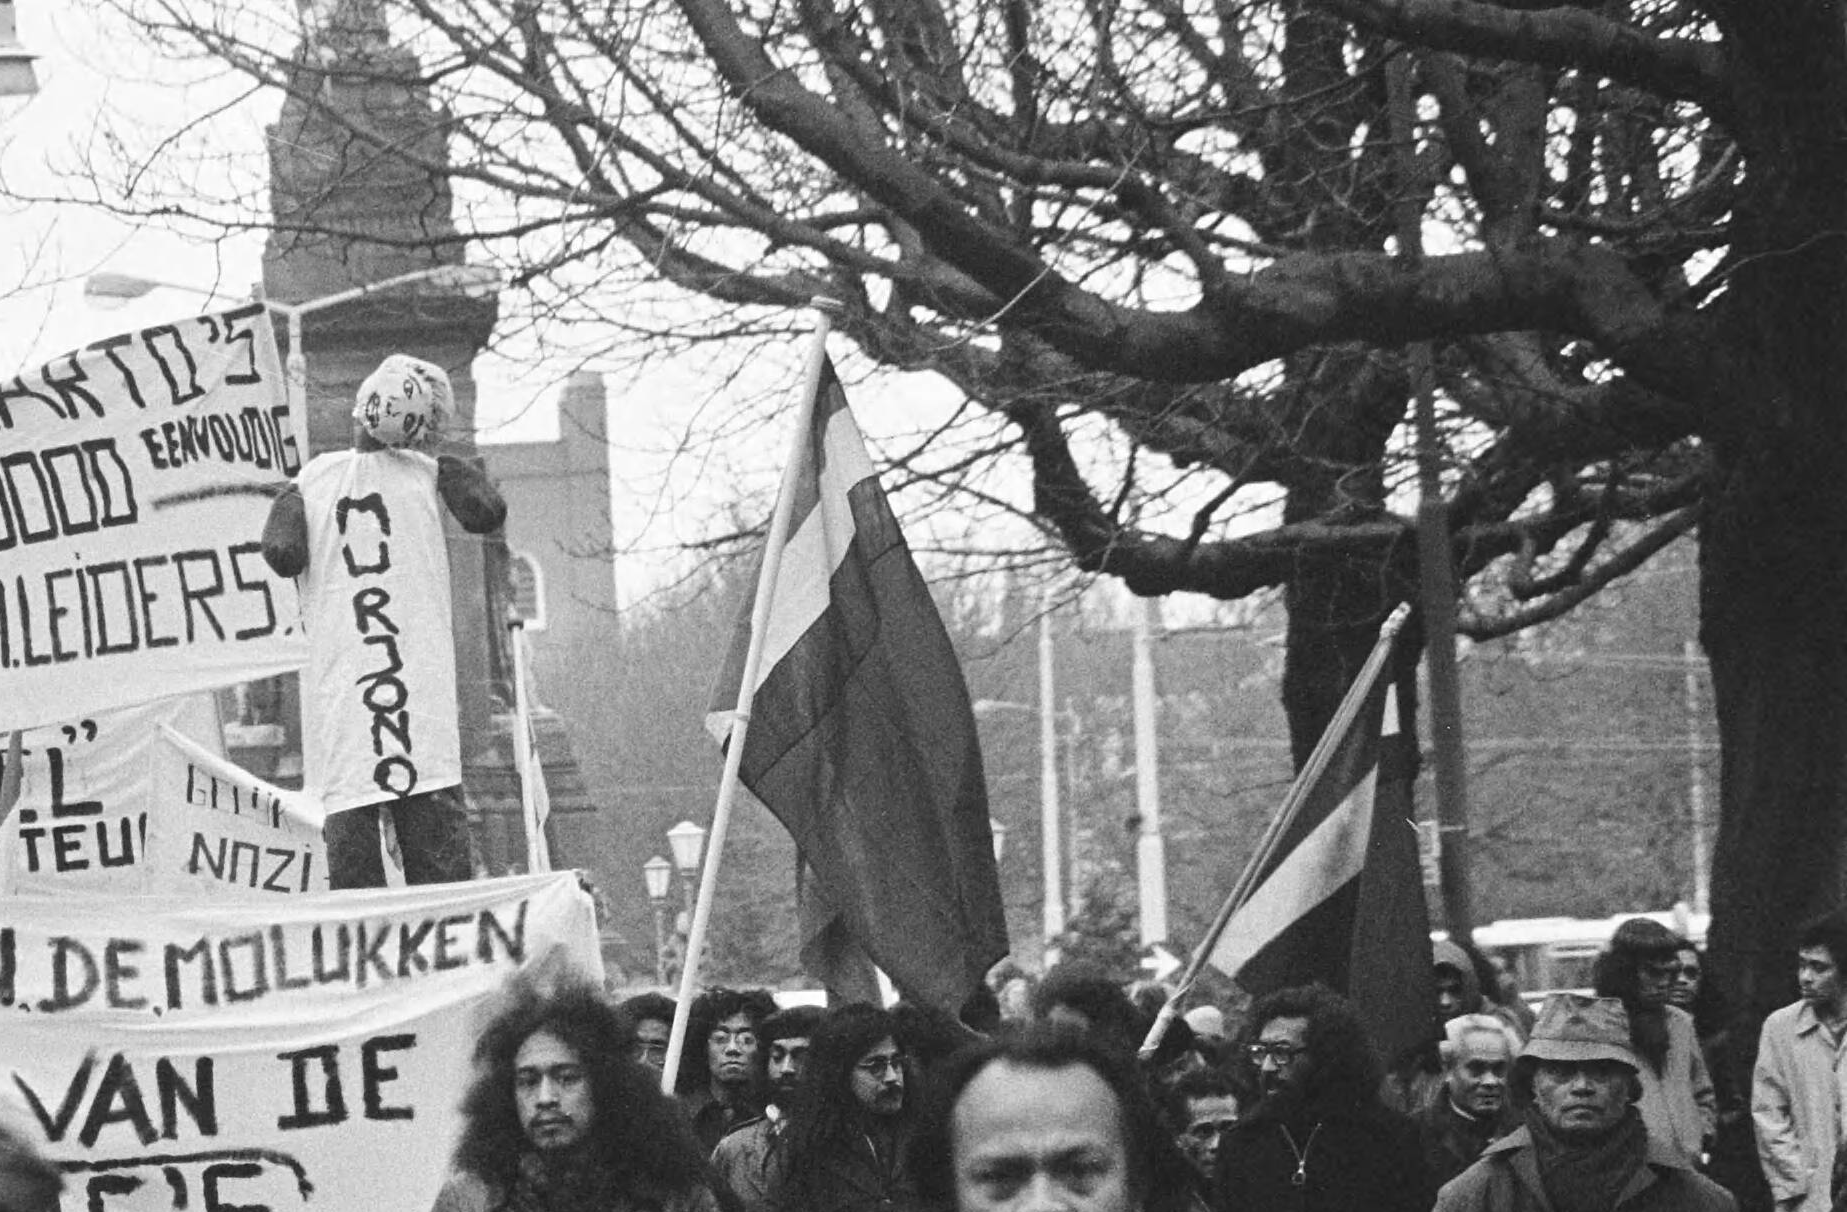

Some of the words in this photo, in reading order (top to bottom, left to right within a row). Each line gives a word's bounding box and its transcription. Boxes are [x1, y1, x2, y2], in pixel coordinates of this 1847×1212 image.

[336, 491, 418, 799] MURJONO
[11, 1045, 219, 1148] VAN
[276, 1033, 418, 1131] DE
